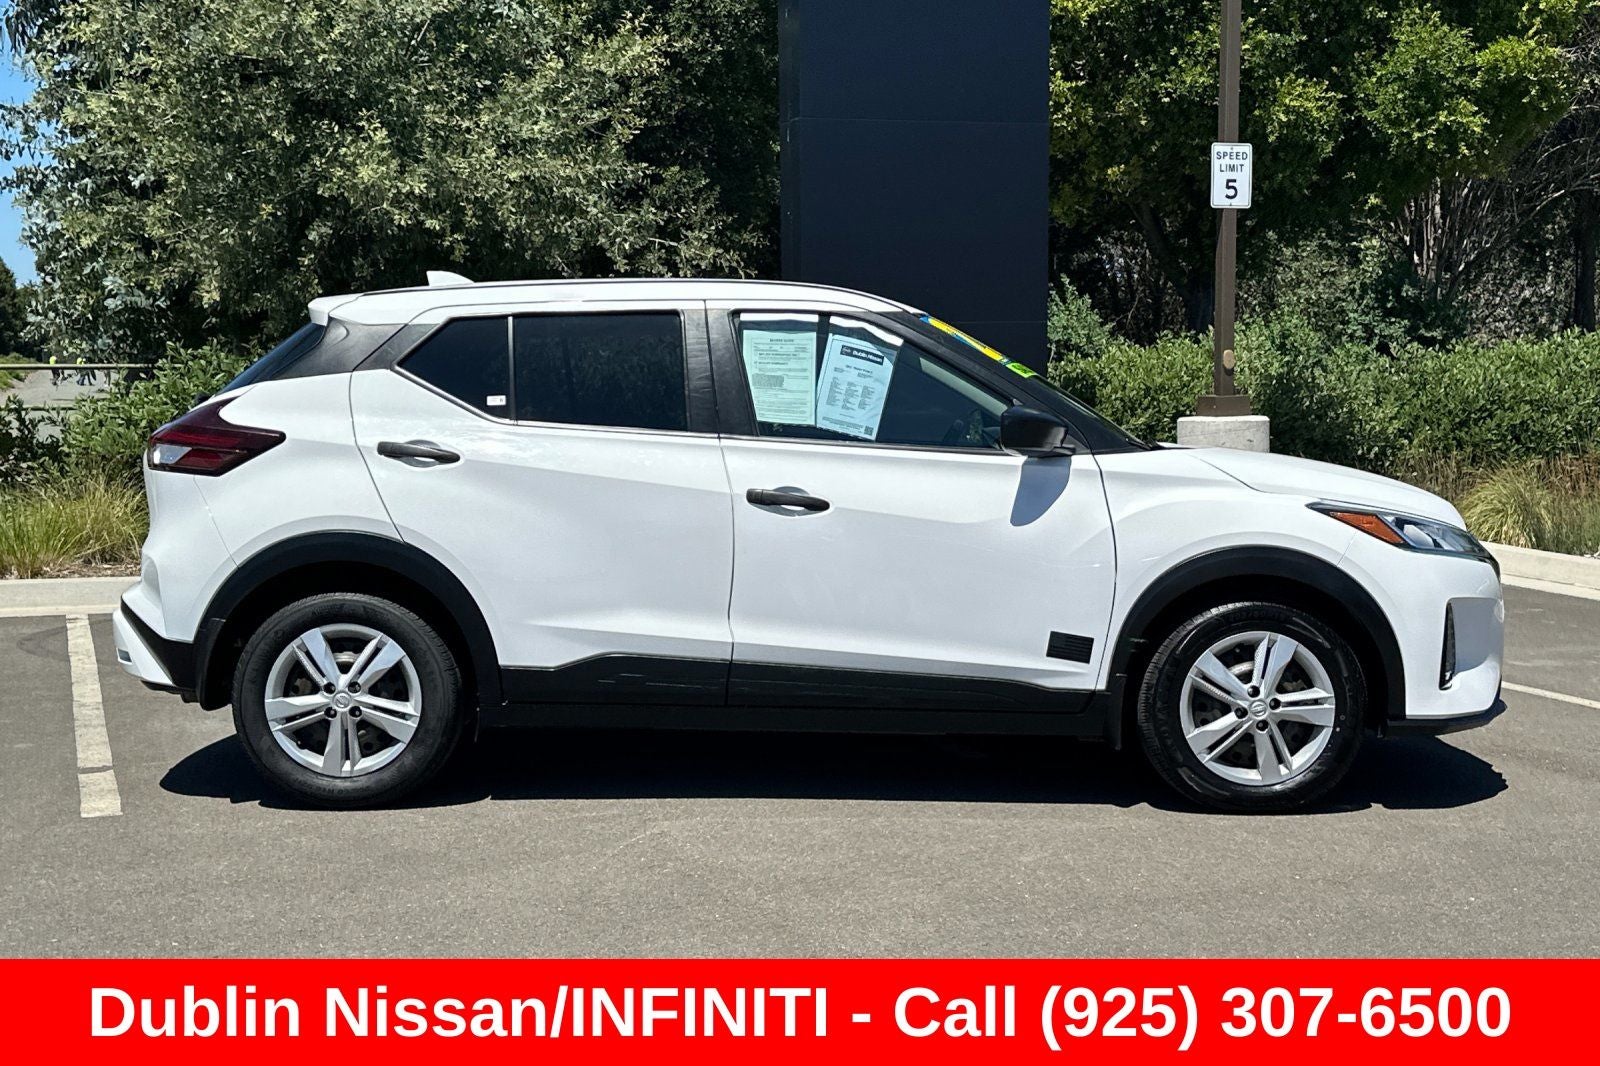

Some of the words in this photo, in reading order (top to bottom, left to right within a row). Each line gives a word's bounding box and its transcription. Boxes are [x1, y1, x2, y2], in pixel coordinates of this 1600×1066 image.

[1216, 151, 1248, 160] SPEED
[1219, 163, 1244, 173] LIMIT
[1225, 178, 1238, 200] 5
